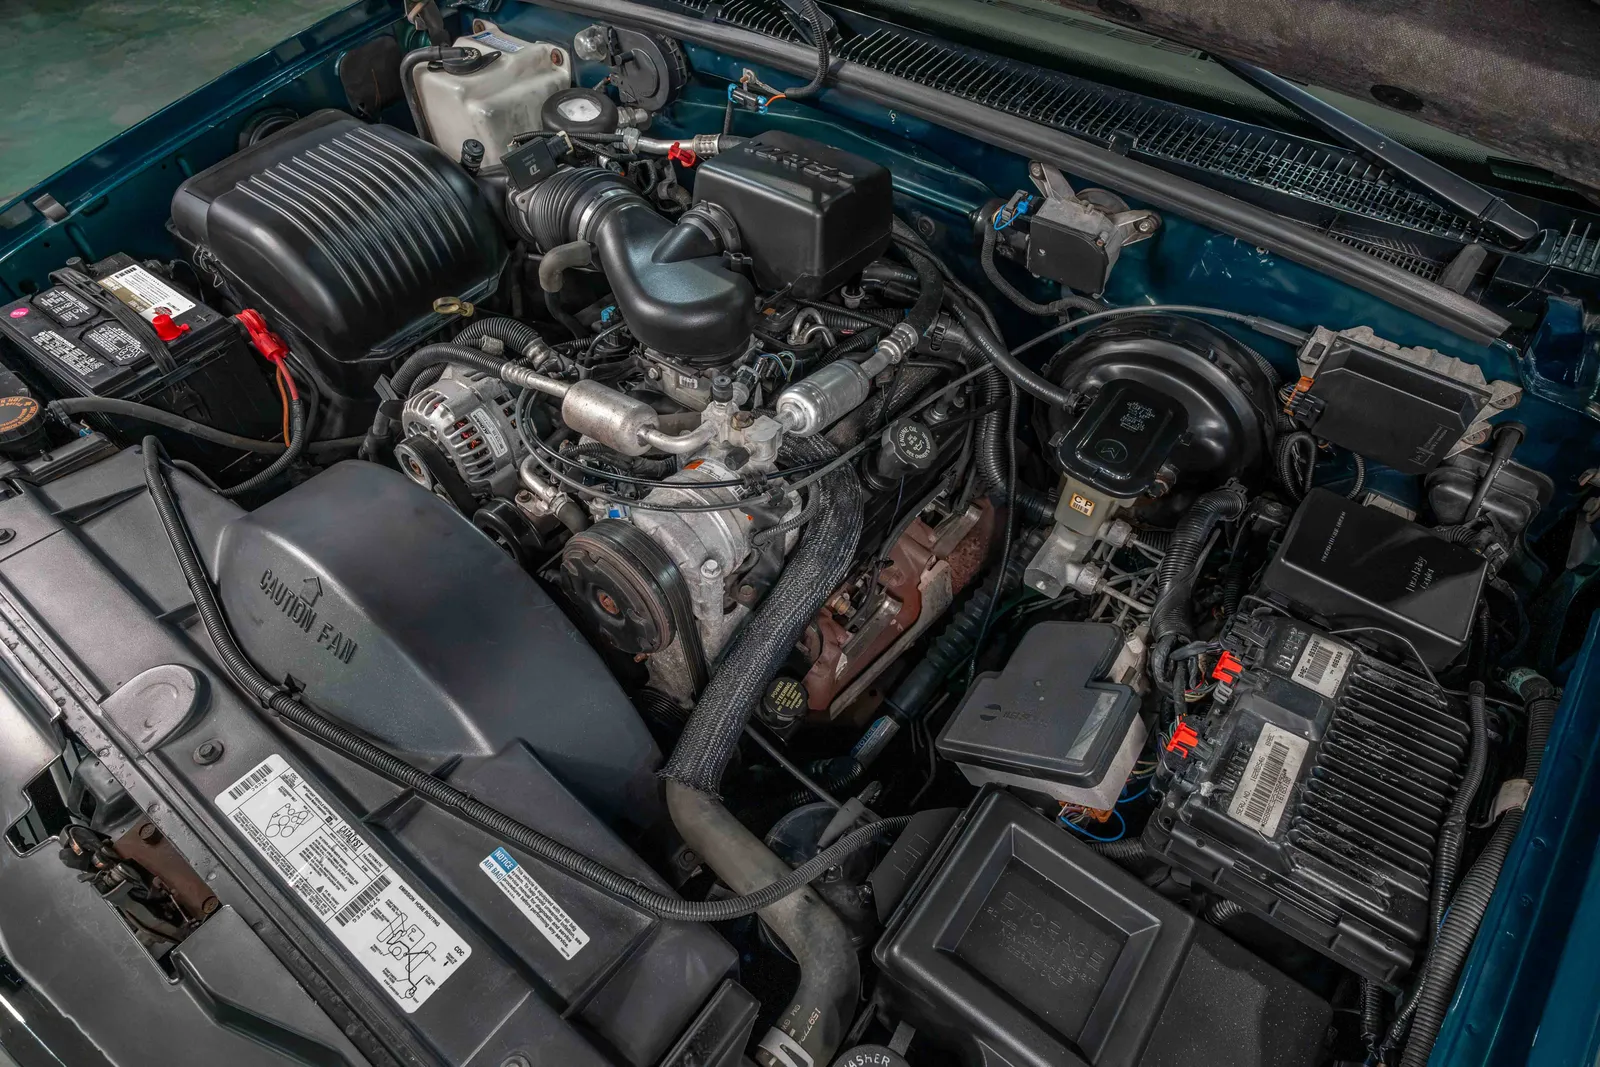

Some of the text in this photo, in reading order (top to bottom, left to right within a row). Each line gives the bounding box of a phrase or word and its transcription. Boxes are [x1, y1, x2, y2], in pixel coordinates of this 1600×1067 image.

[898, 426, 909, 446] ENGINE
[259, 568, 358, 665] CAUTION FAN
[770, 680, 784, 698] POWER
[338, 824, 364, 849] CATALYST
[482, 858, 503, 880] AIR BAG
[494, 849, 513, 870] NOTICE
[397, 884, 416, 902] EMISSION
[413, 900, 425, 912] HOSE
[423, 909, 440, 927] ROUTING
[506, 873, 519, 887] service
[517, 885, 531, 899] manual
[551, 920, 560, 930] and
[557, 928, 572, 943] service
[514, 866, 524, 876] This
[521, 873, 535, 887] vehicle
[535, 888, 554, 907] equipped
[551, 904, 561, 914] with
[567, 922, 577, 932] bag
[452, 945, 465, 957] CDC
[790, 1003, 800, 1016] GM
[843, 1053, 890, 1067] ASHER
